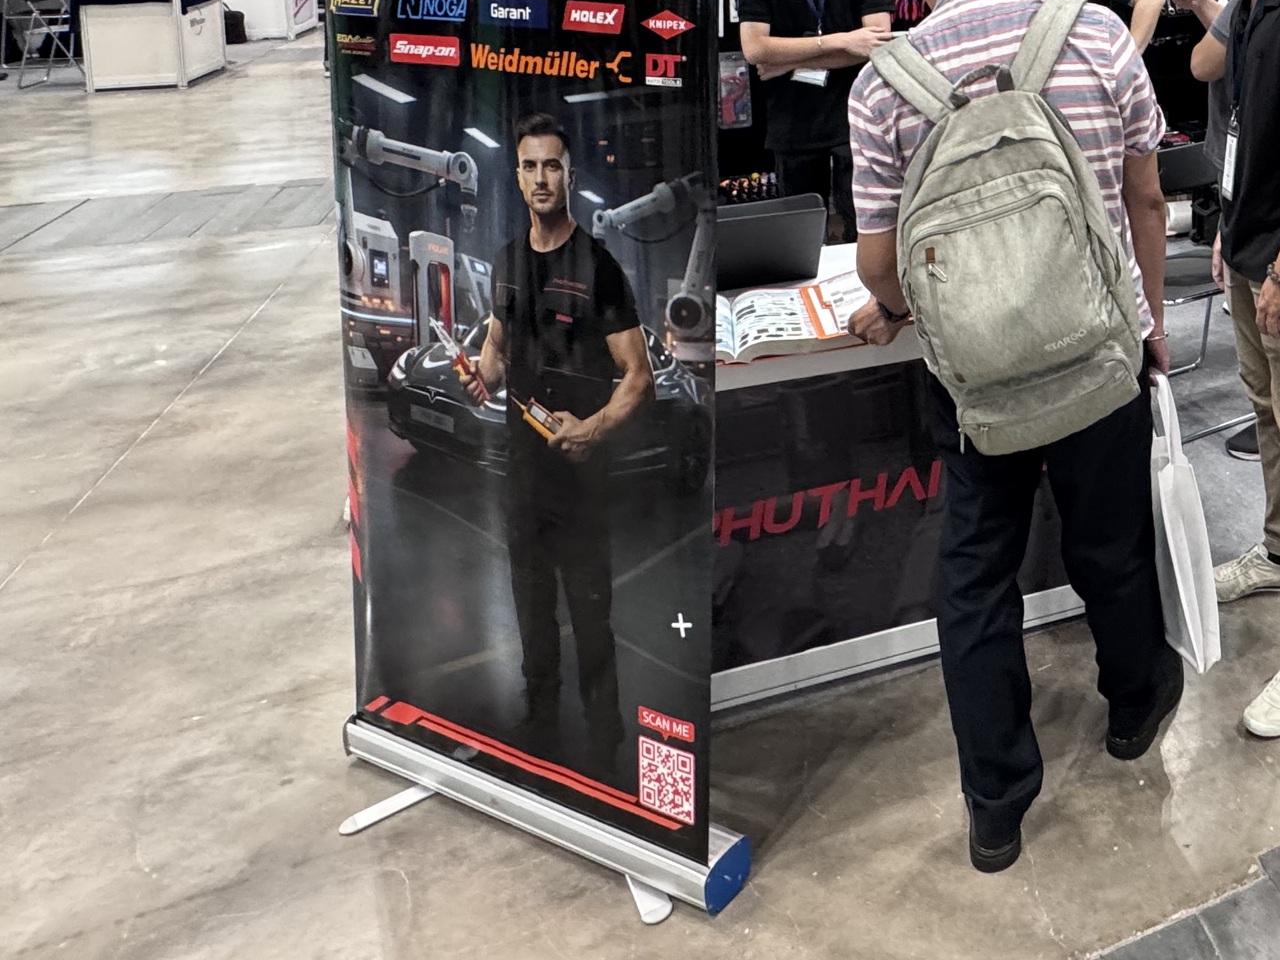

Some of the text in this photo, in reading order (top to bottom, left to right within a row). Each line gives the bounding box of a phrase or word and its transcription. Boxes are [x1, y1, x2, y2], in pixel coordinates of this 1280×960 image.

[490, 3, 531, 20] Garant
[570, 9, 618, 25] HOLEX
[649, 19, 686, 30] KNIPEX
[393, 40, 455, 57] Snap-on
[470, 43, 599, 79] Weidmüller
[646, 53, 681, 77] DT
[713, 457, 943, 547] HUTHAI
[642, 711, 690, 737] SCAN ME
